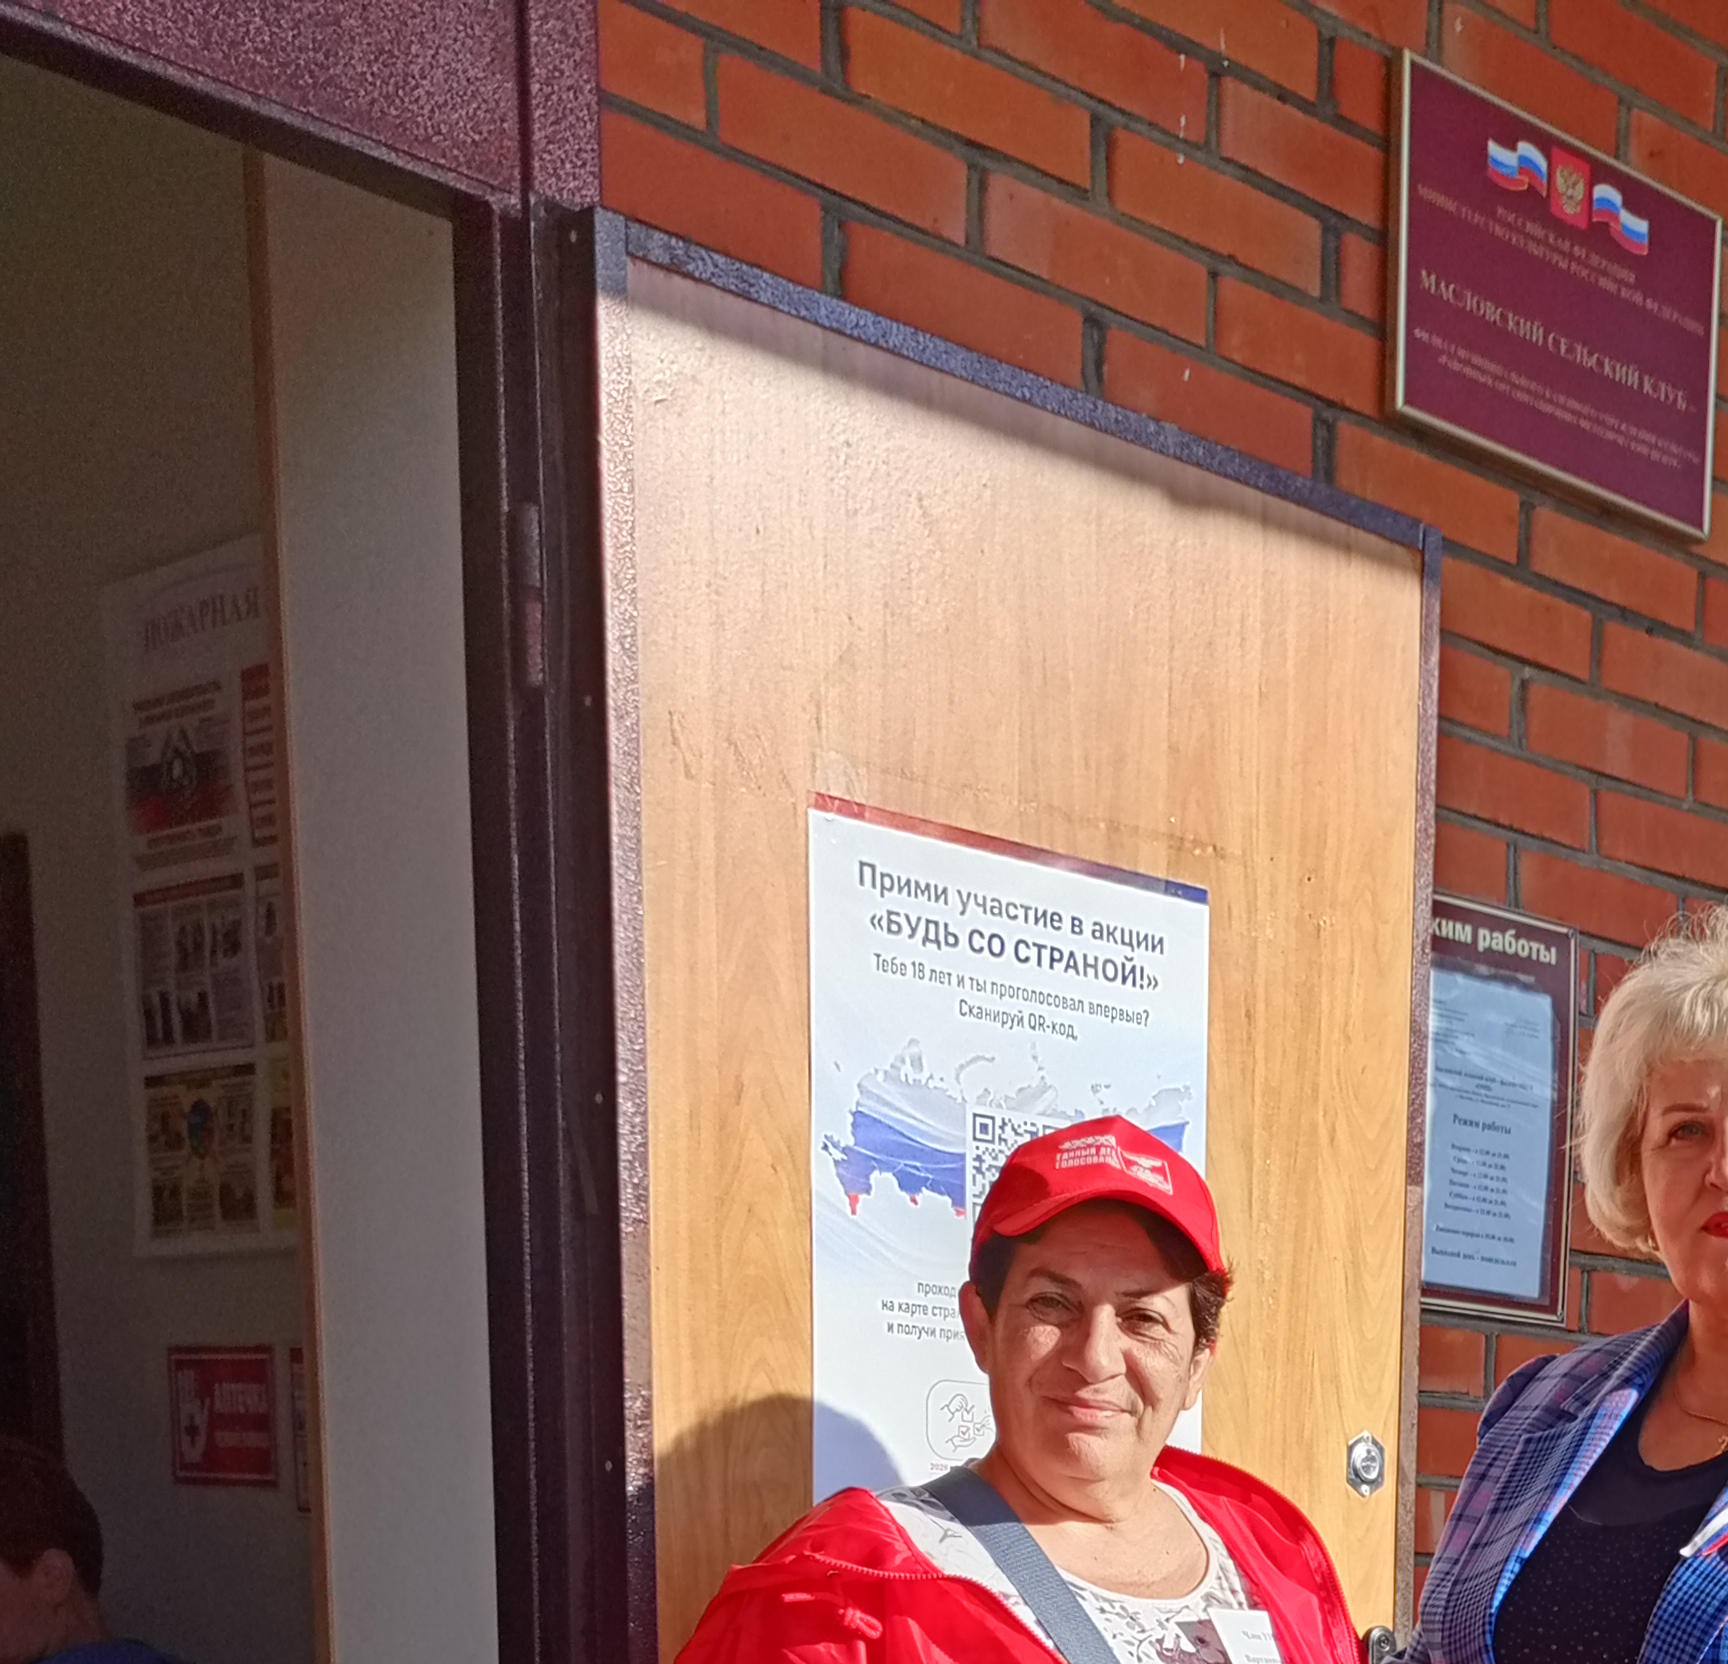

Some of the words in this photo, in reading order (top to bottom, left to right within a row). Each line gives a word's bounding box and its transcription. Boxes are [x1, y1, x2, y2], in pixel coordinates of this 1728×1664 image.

[1420, 267, 1544, 347] МАСЛОВСКИЙ
[1548, 330, 1640, 390] СЕЛЬСКИЙ
[1643, 374, 1688, 413] КЛУБ
[858, 860, 949, 906] Прими
[957, 887, 1064, 931] участие
[1070, 917, 1084, 935] в
[1091, 920, 1165, 955] акции
[870, 910, 960, 951] «БУДЬ
[968, 929, 1006, 959] СО
[1014, 939, 1159, 991] СТРАНОЙ!»
[1478, 926, 1557, 966] работы
[874, 953, 907, 977] Тебе
[911, 961, 925, 981] 18
[929, 968, 952, 987] лет
[957, 974, 965, 988] и
[969, 977, 987, 992] ты
[991, 983, 1085, 1014] проголосовал
[1088, 1002, 1149, 1028] впервые?
[959, 1000, 1025, 1030] Сканируй
[1029, 1012, 1078, 1041] QR-код,
[1453, 1114, 1480, 1129] Режим
[1482, 1121, 1512, 1135] работы
[882, 1299, 895, 1312] на
[898, 1302, 928, 1318] карте
[932, 1305, 960, 1321] стра
[917, 1281, 956, 1299] проход
[887, 1323, 894, 1334] и
[897, 1322, 936, 1341] получи
[939, 1327, 966, 1342] прия
